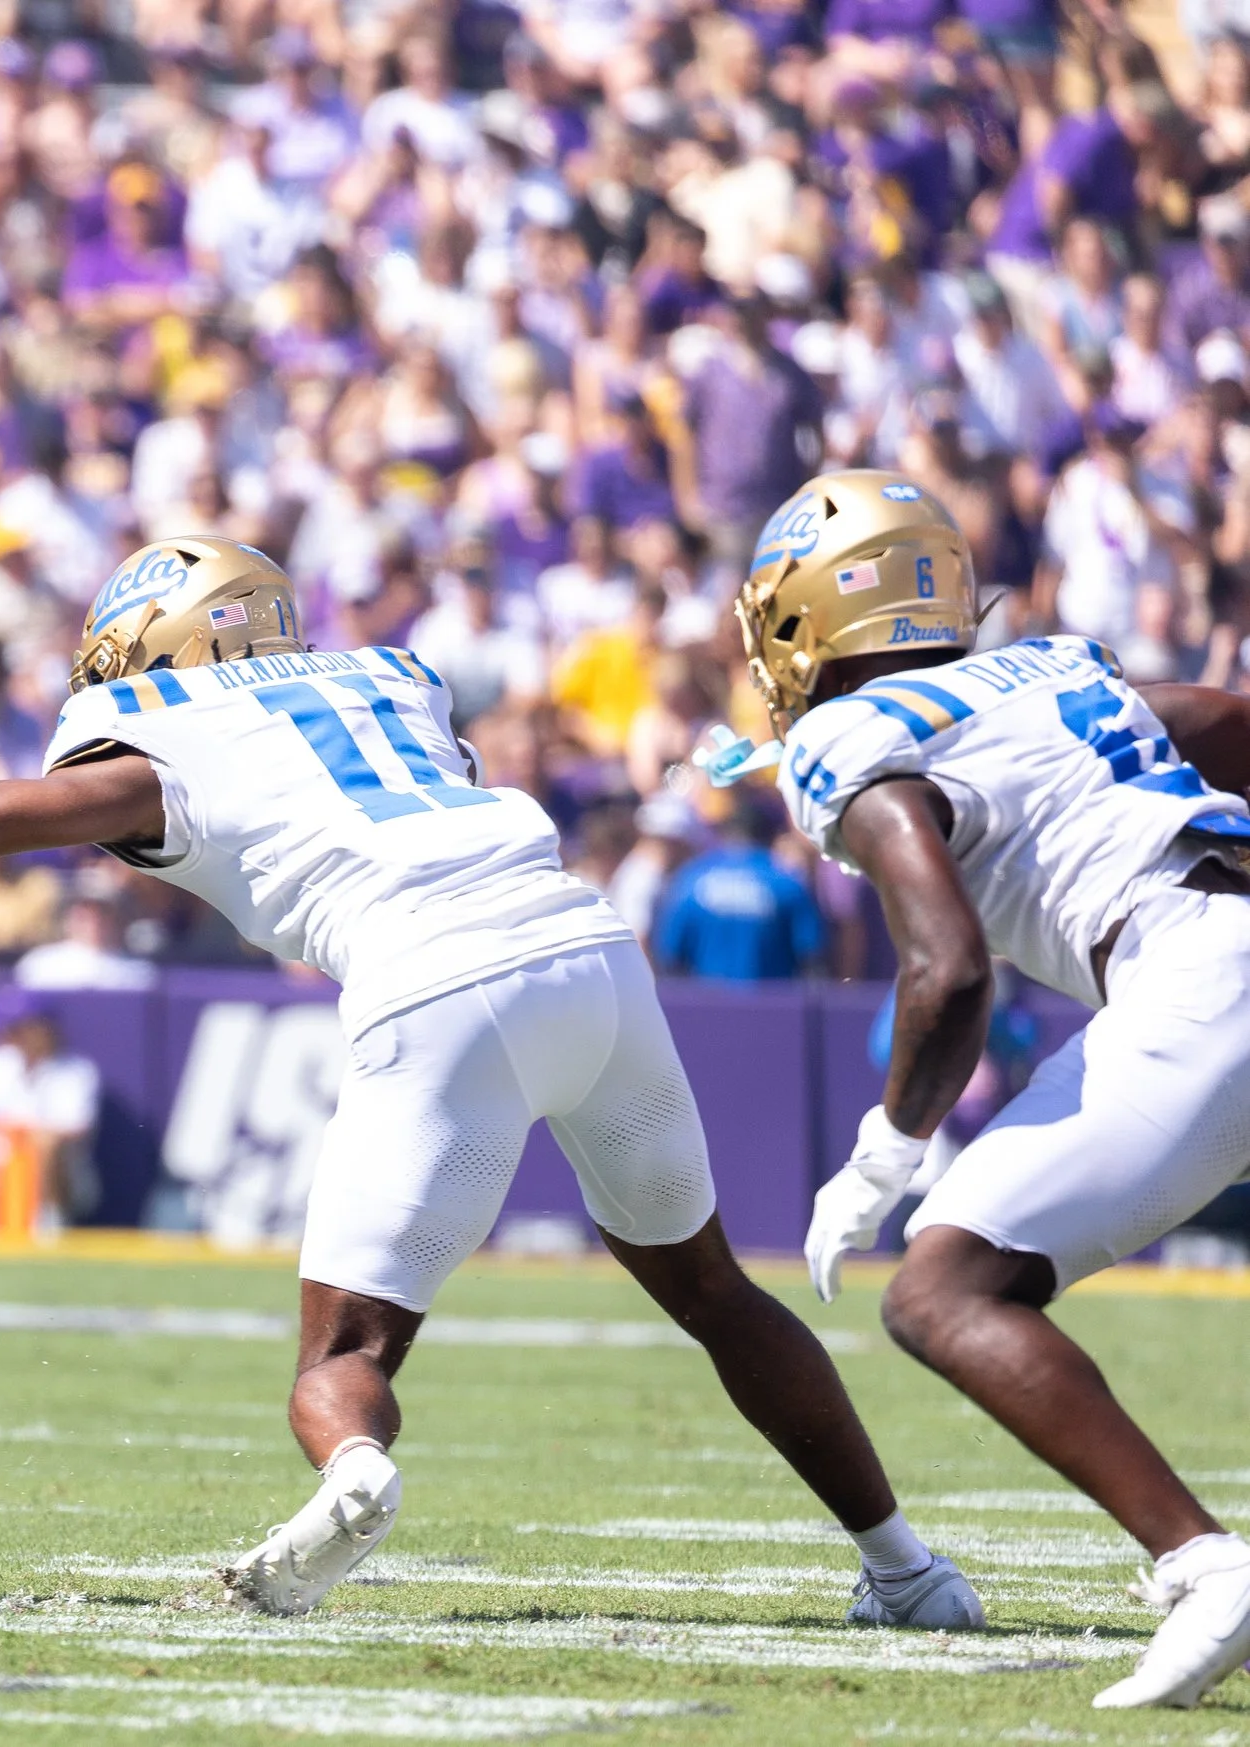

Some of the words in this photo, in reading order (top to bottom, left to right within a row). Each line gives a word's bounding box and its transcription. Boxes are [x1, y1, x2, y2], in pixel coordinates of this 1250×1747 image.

[915, 556, 935, 599] 6
[887, 616, 958, 644] Bruins
[207, 651, 368, 689] HENDERSON
[956, 645, 1082, 693] DAVIE
[250, 674, 502, 823] 11
[791, 743, 836, 806] 6
